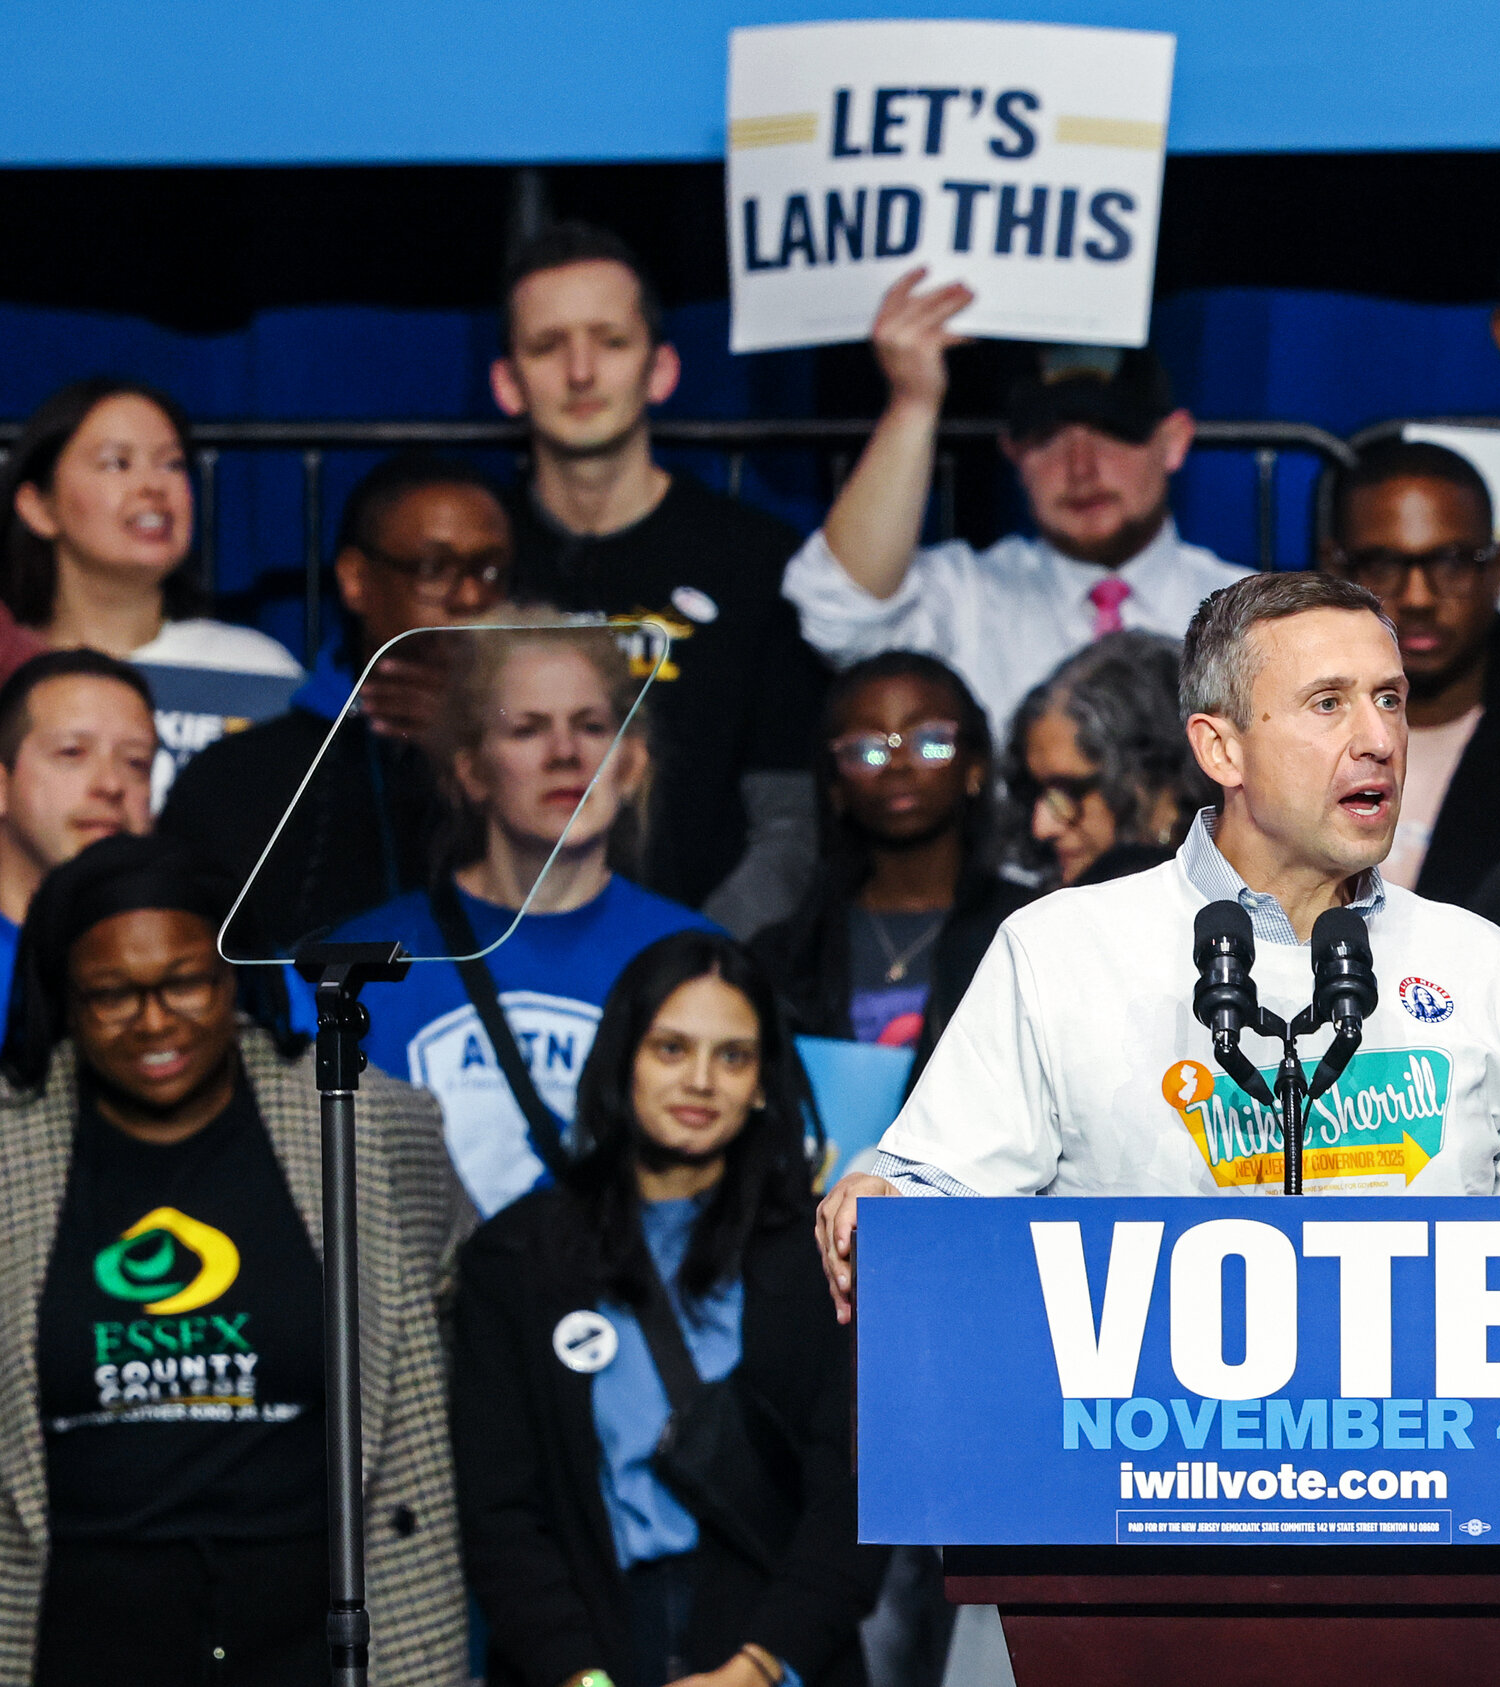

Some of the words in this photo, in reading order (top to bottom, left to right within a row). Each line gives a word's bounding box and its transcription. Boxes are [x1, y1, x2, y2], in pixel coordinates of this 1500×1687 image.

[831, 85, 1042, 160] LET'S
[743, 184, 922, 272] LAND
[942, 180, 1138, 263] THIS
[461, 1030, 575, 1070] ATN
[1186, 1093, 1312, 1167] Mik
[1313, 1054, 1444, 1145] Sherrill
[1235, 1159, 1264, 1179] NEW
[1264, 1157, 1309, 1177] JERY
[1312, 1152, 1376, 1172] GOVERNOR
[1377, 1149, 1406, 1168] 2025
[93, 1312, 252, 1364] ESSEX
[94, 1352, 258, 1389] COUNTY
[98, 1376, 256, 1408] COLLEGE
[1063, 1398, 1475, 1450] NOVEMBER
[1120, 1462, 1448, 1500] iwillvote.com
[1128, 1522, 1144, 1532] PAID
[1145, 1522, 1157, 1532] FOR
[1158, 1522, 1167, 1532] BY
[1168, 1522, 1180, 1532] THE
[1181, 1522, 1196, 1532] NEW
[1197, 1522, 1219, 1532] JERSEY
[1221, 1522, 1260, 1532] DEMOCRATIC
[1262, 1522, 1279, 1532] STATE
[1281, 1522, 1315, 1532] COMMITTEE
[1317, 1522, 1328, 1532] 142
[1329, 1522, 1336, 1532] W
[1337, 1522, 1354, 1532] STATE
[1356, 1522, 1378, 1532] STREET
[1379, 1522, 1408, 1532] TRENTON
[1409, 1522, 1417, 1532] NJ
